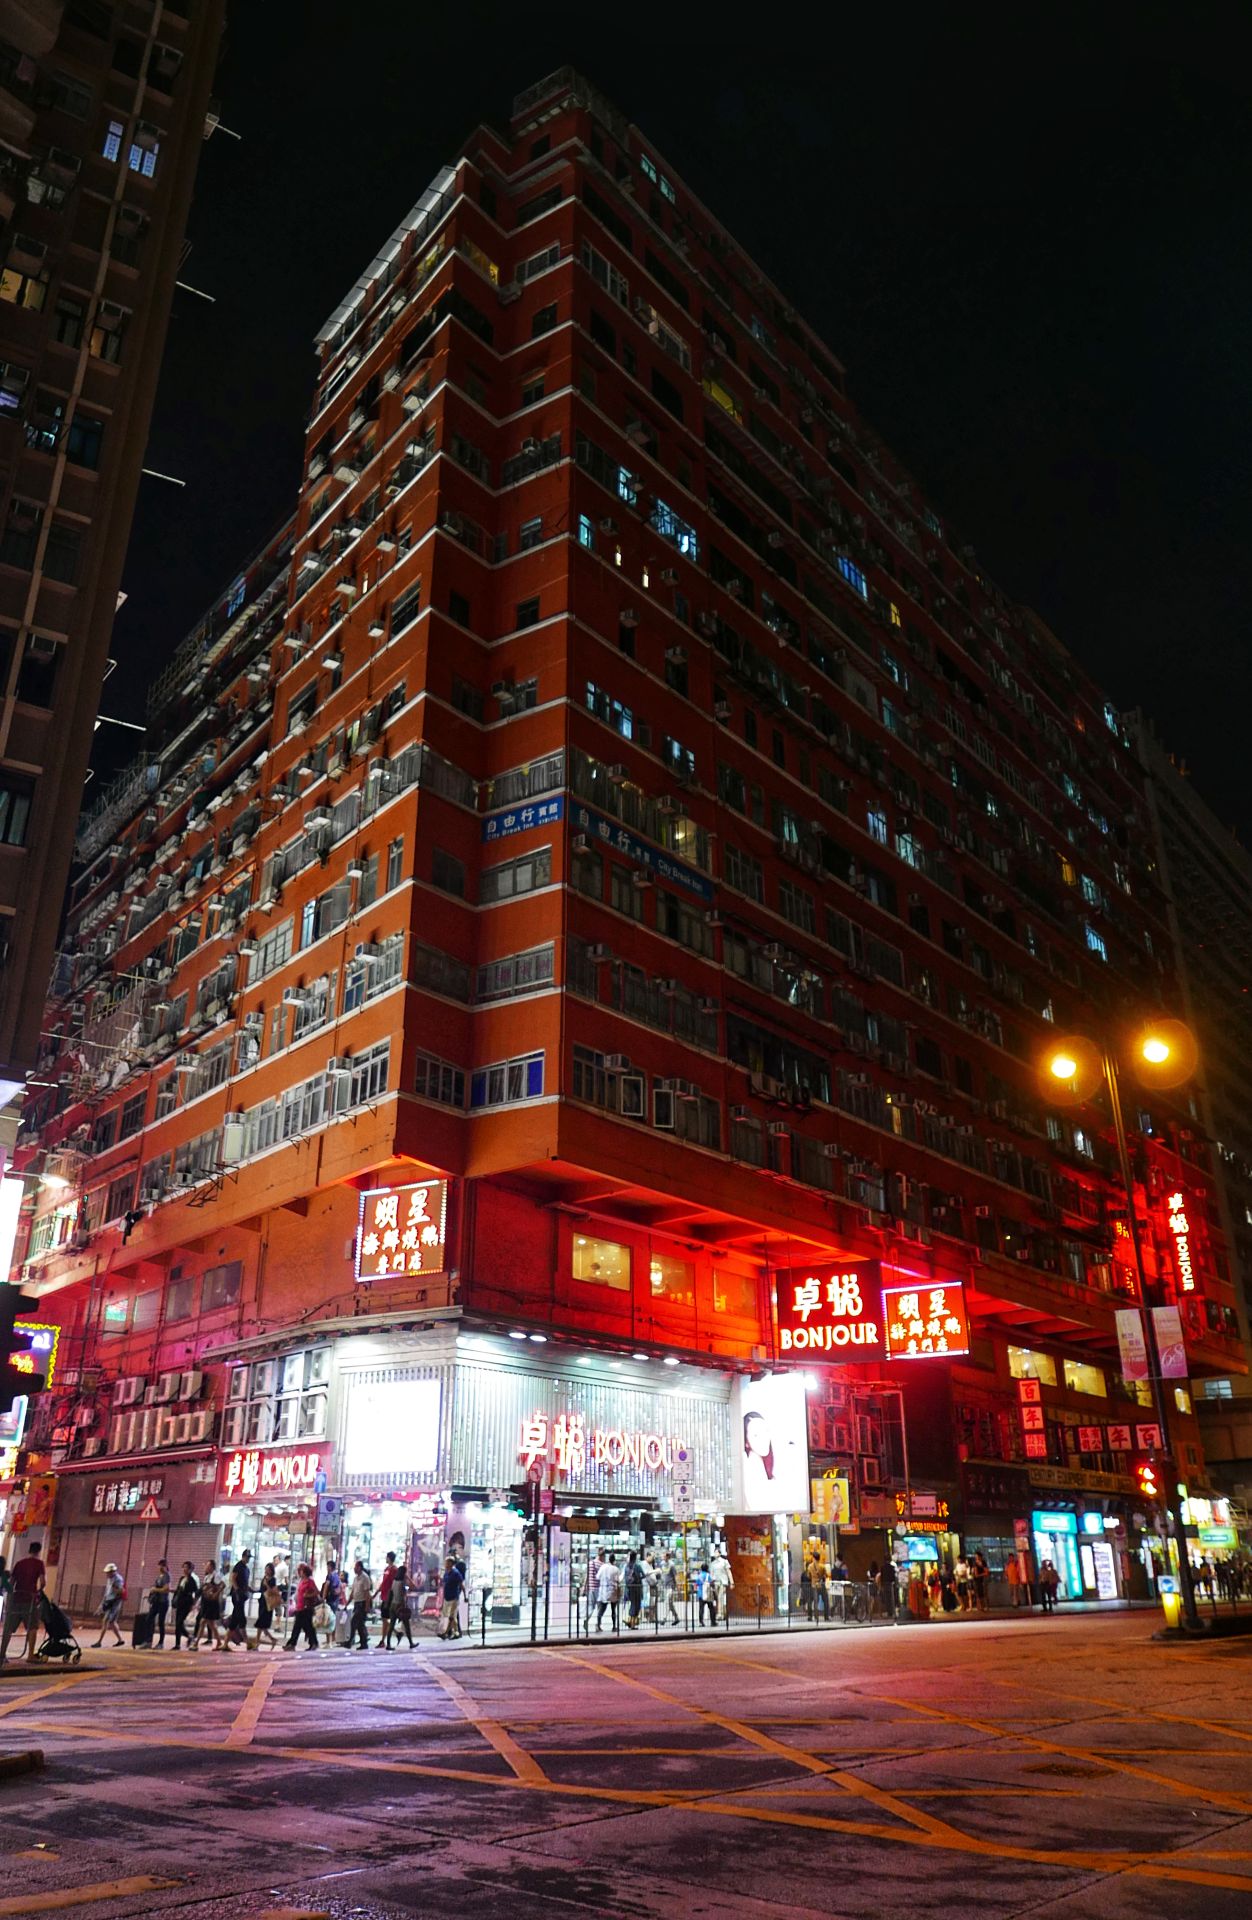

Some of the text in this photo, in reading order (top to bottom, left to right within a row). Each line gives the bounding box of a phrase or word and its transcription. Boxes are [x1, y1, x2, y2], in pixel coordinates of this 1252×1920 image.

[502, 826, 521, 836] Break
[523, 822, 534, 830] Inn
[658, 859, 673, 877] City
[673, 866, 691, 885] Break
[692, 880, 703, 892] Inn
[375, 1189, 430, 1228] 明星
[1176, 1236, 1194, 1291] BONJOUR
[898, 1289, 950, 1319] 明星
[780, 1323, 879, 1350] BONJOUR
[1022, 1382, 1040, 1427] 百年
[261, 1454, 320, 1489] BONJOUR
